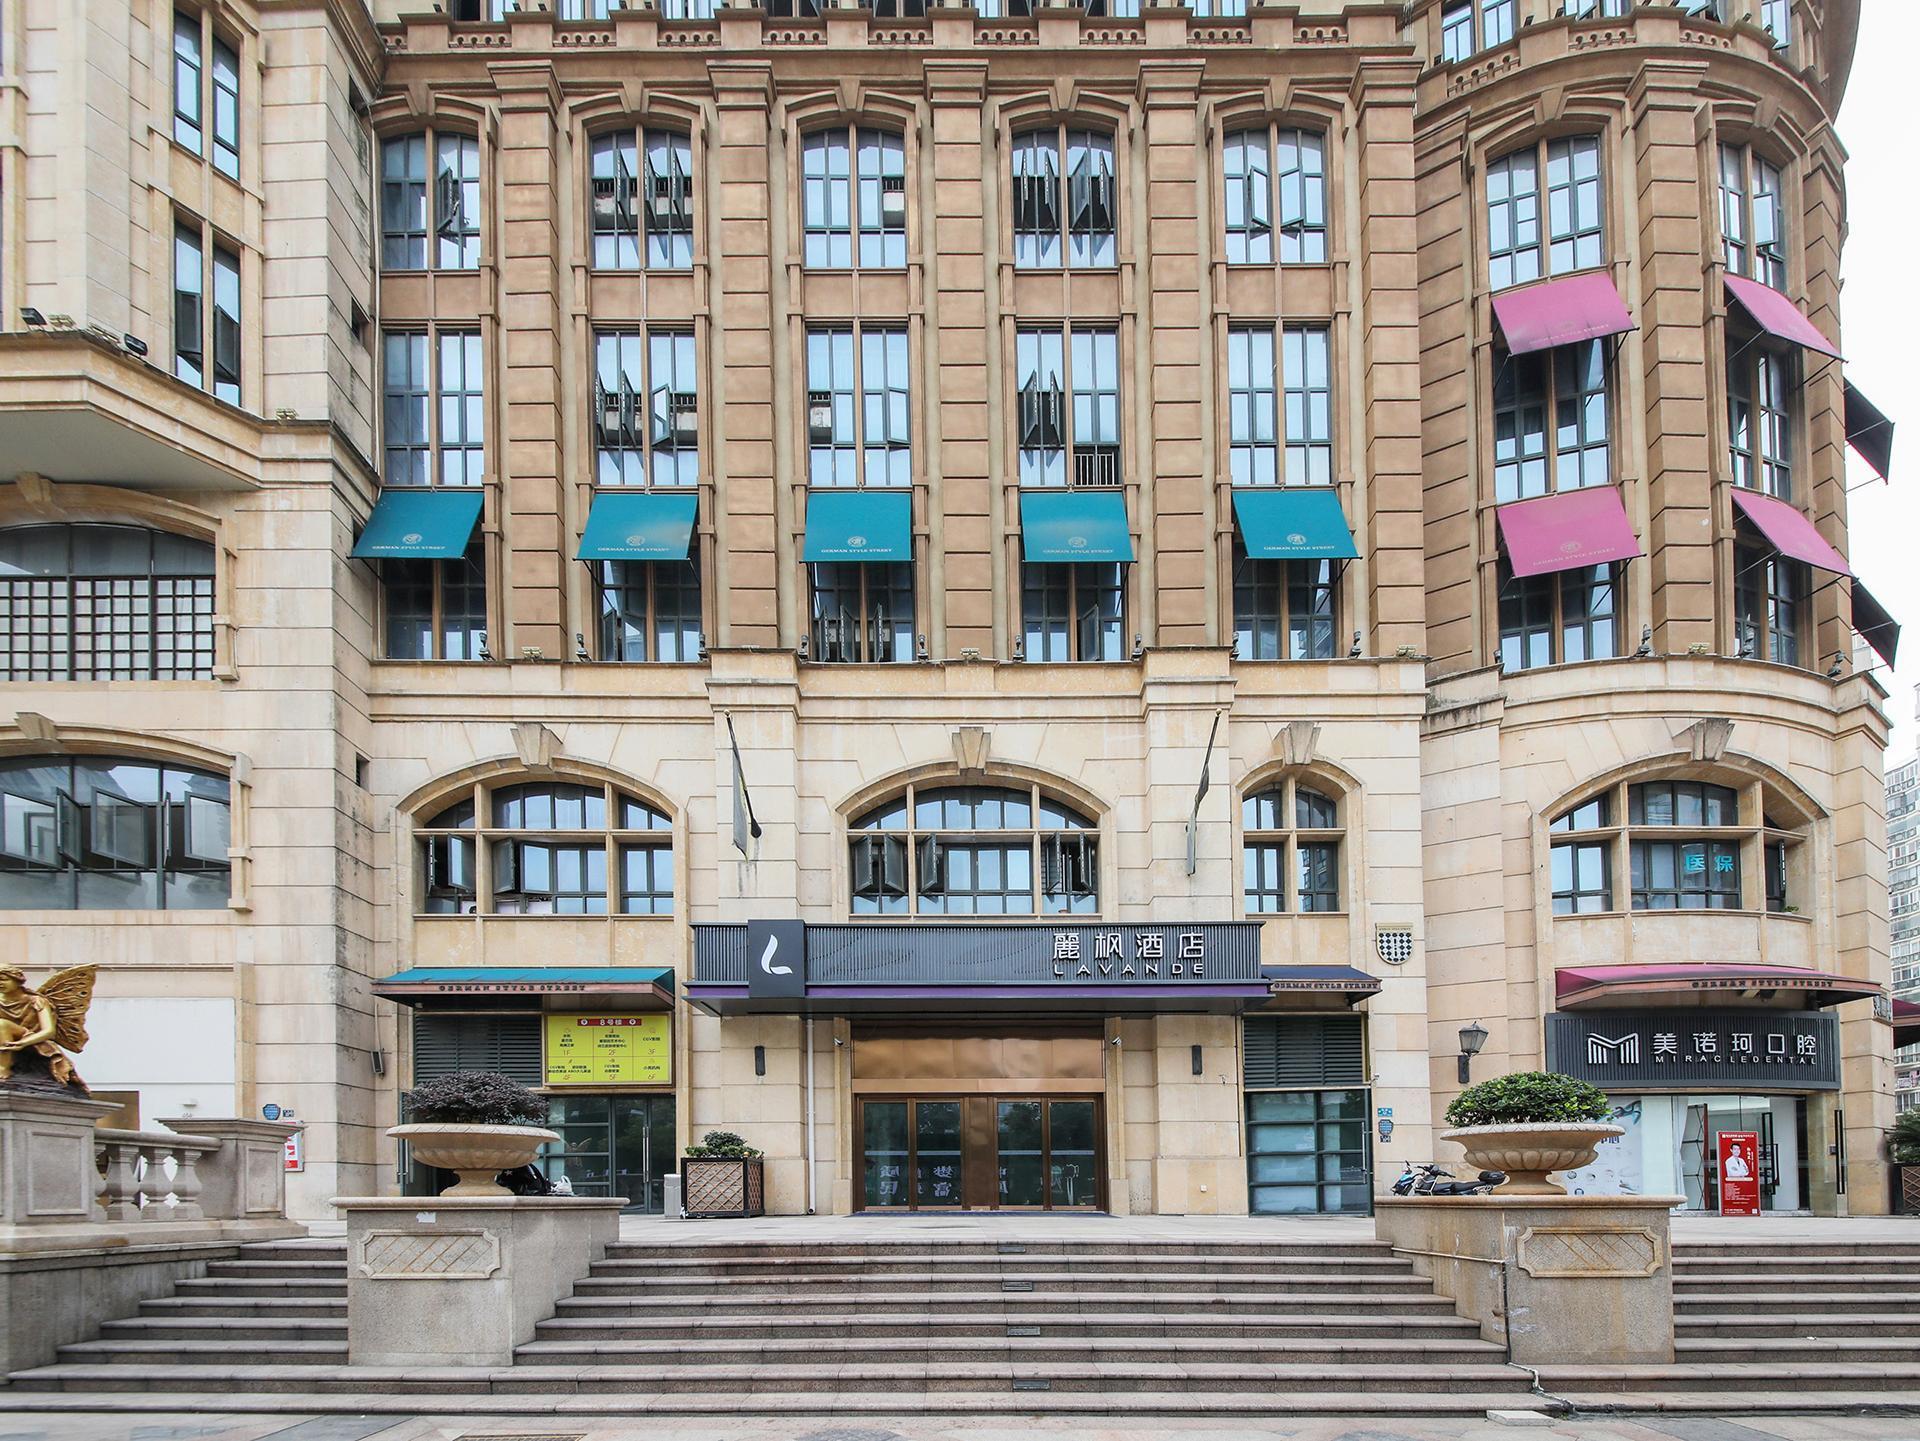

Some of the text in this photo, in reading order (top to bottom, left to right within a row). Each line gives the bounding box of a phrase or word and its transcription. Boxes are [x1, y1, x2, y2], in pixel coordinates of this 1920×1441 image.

[1686, 853, 1734, 873] 医保
[1052, 931, 1204, 959] 麗枫酒店
[1054, 963, 1204, 975] LAVANDE
[1653, 1032, 1817, 1055] 美诺珂口腔
